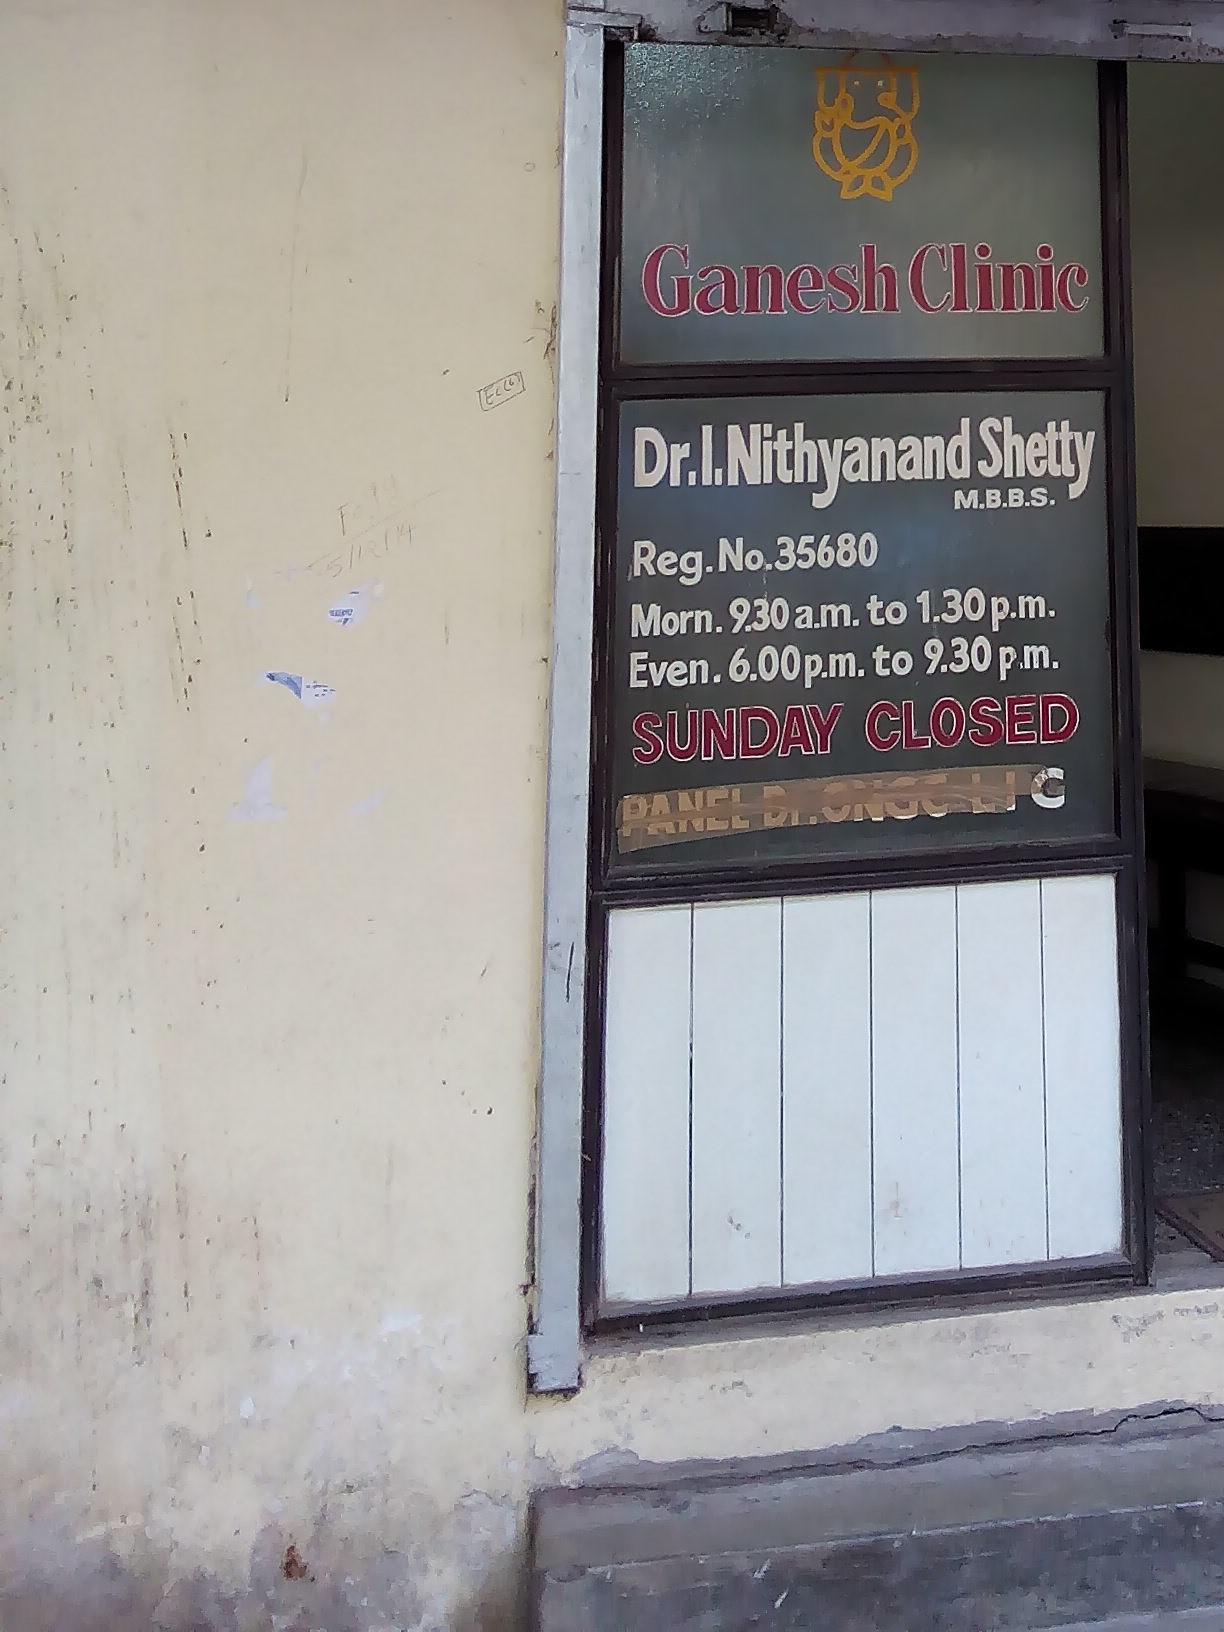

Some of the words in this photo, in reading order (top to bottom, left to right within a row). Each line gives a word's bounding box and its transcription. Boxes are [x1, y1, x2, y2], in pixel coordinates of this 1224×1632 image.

[641, 243, 901, 318] Ganesh
[909, 242, 1090, 316] Clinic
[978, 416, 1096, 500] Shetty
[954, 487, 1056, 510] M.B.B.S.
[631, 602, 723, 638] Morn.
[867, 595, 907, 628] to
[916, 588, 985, 624] 1.30
[991, 594, 1056, 632] p.m.
[630, 652, 721, 689] Even.
[873, 645, 913, 676] to
[924, 636, 991, 674] 9.30
[1000, 643, 1059, 680] p.m.
[632, 703, 844, 765] SUNDAY
[865, 693, 1080, 752] CLOSED
